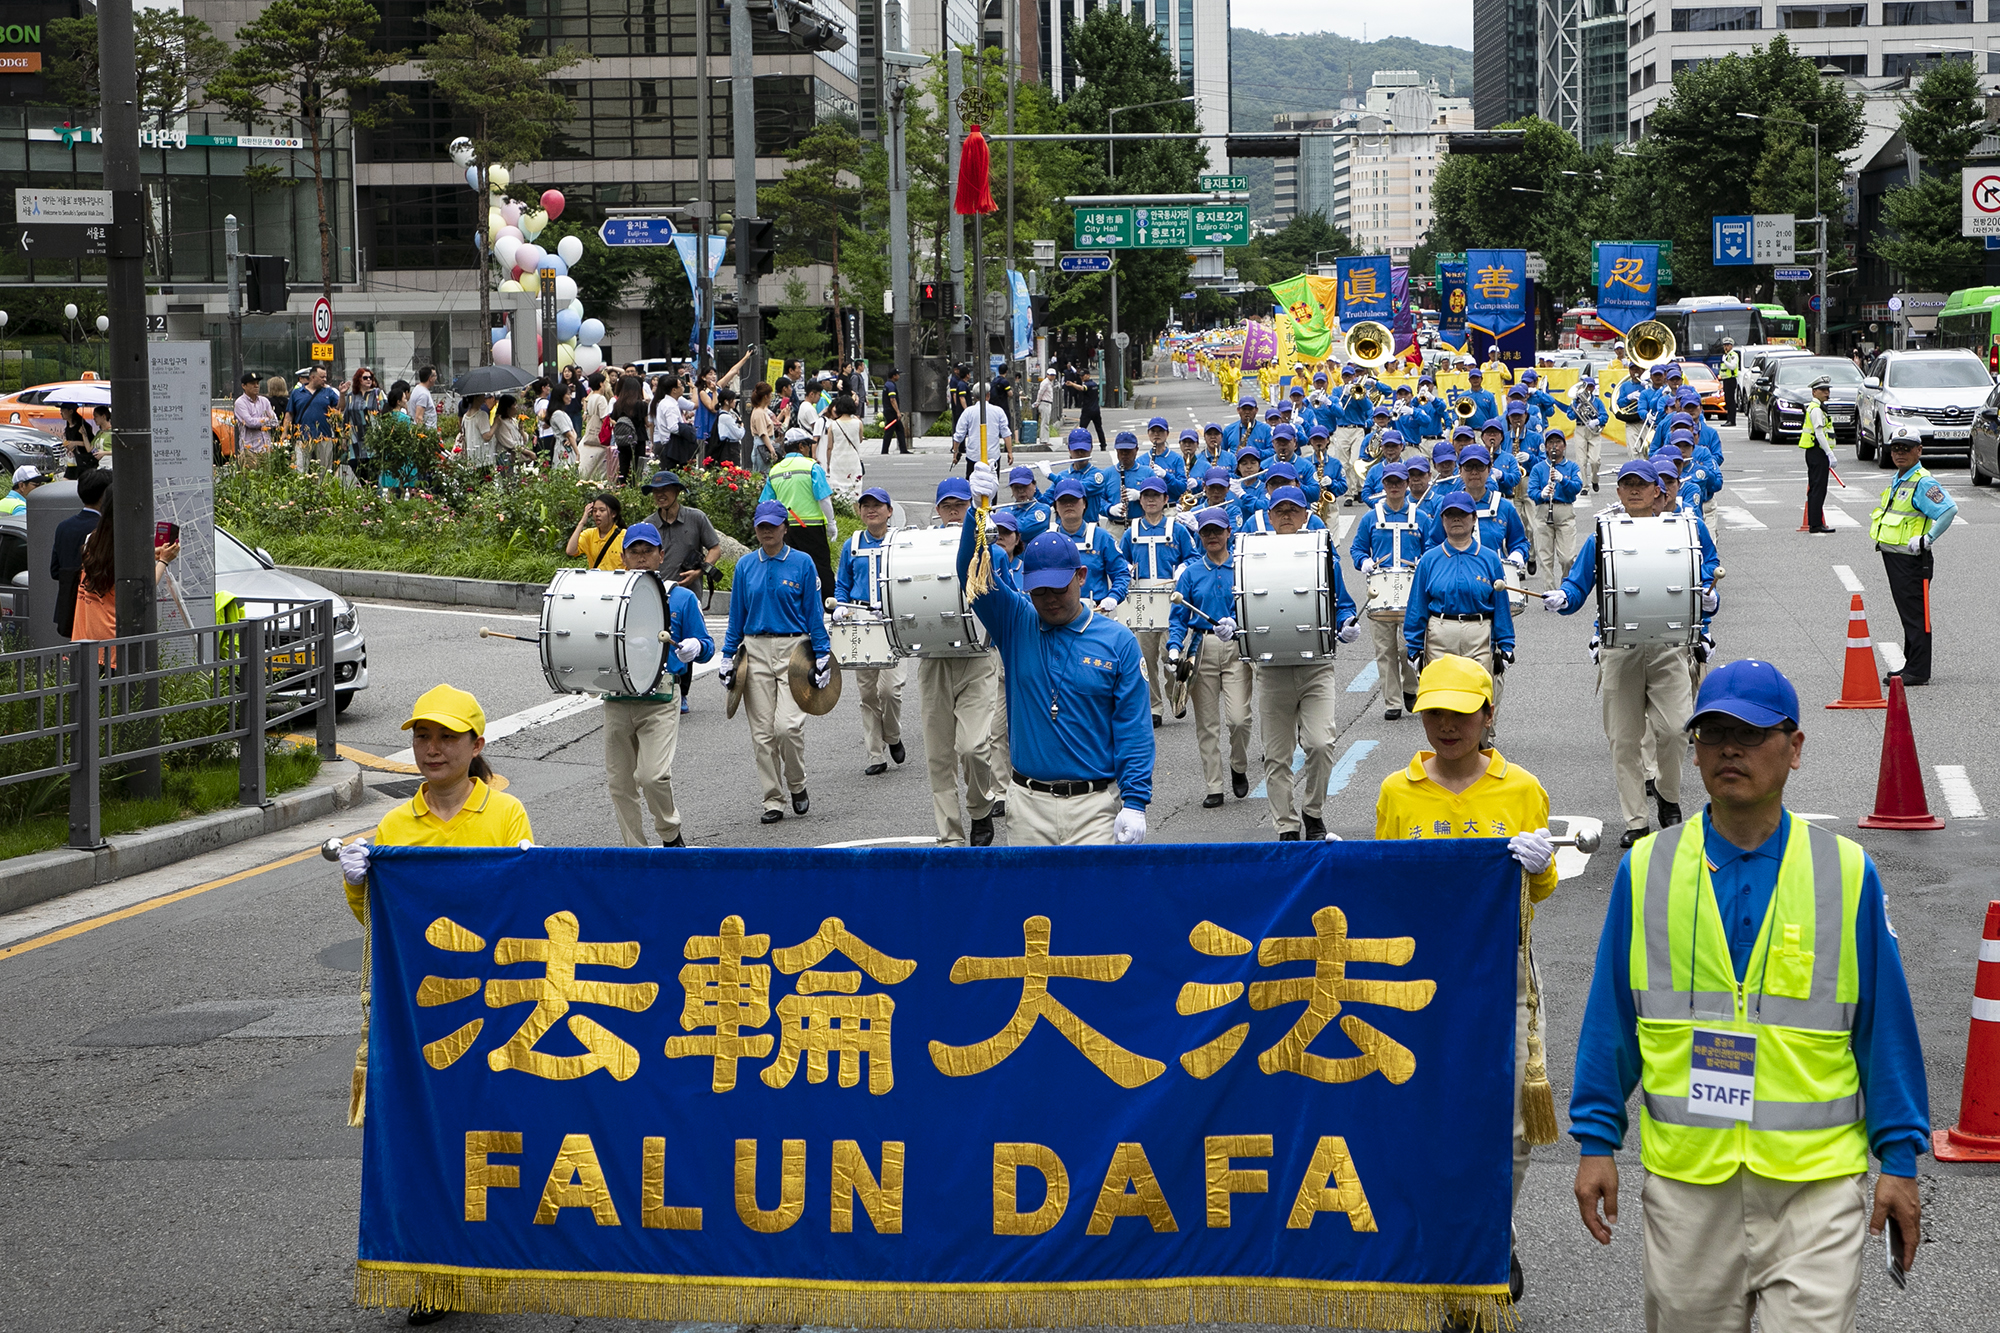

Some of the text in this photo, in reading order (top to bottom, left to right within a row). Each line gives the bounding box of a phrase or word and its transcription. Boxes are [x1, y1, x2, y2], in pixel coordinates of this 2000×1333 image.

[1203, 177, 1246, 189] 을지로1가
[1084, 213, 1105, 224] 시청
[1150, 210, 1189, 220] 안국동사거리
[1195, 211, 1244, 222] 을지로2가
[626, 220, 649, 230] 을지로
[1139, 218, 1145, 227] 6
[1196, 223, 1218, 231] Euljiro
[86, 227, 106, 240] 서울로
[1084, 225, 1101, 233] City
[1151, 228, 1186, 238] 종로1가
[1083, 235, 1091, 243] 31
[1604, 256, 1652, 293] 忍
[1473, 264, 1520, 299] 善
[1473, 302, 1520, 310] Compassion
[1603, 297, 1651, 306] Forbearance
[1345, 310, 1388, 318] Truthfulness
[156, 316, 165, 329] 2
[318, 309, 329, 332] 50
[1781, 323, 1794, 331] 7021
[314, 346, 333, 357] 도심부
[151, 357, 188, 366] 을지로입구역
[151, 383, 168, 391] 보신각
[152, 405, 183, 413] 을지로3가역
[152, 427, 169, 435] 덕수궁
[152, 449, 181, 457] 남대문시장
[1392, 573, 1400, 606] majestic
[1134, 593, 1143, 627] majestic
[850, 625, 858, 662] majestic
[1409, 818, 1507, 840] 法輪大法
[416, 905, 1437, 1096] 法輪大法
[1691, 1082, 1751, 1106] STAFF
[464, 1130, 1379, 1236] FALUN DAFA
